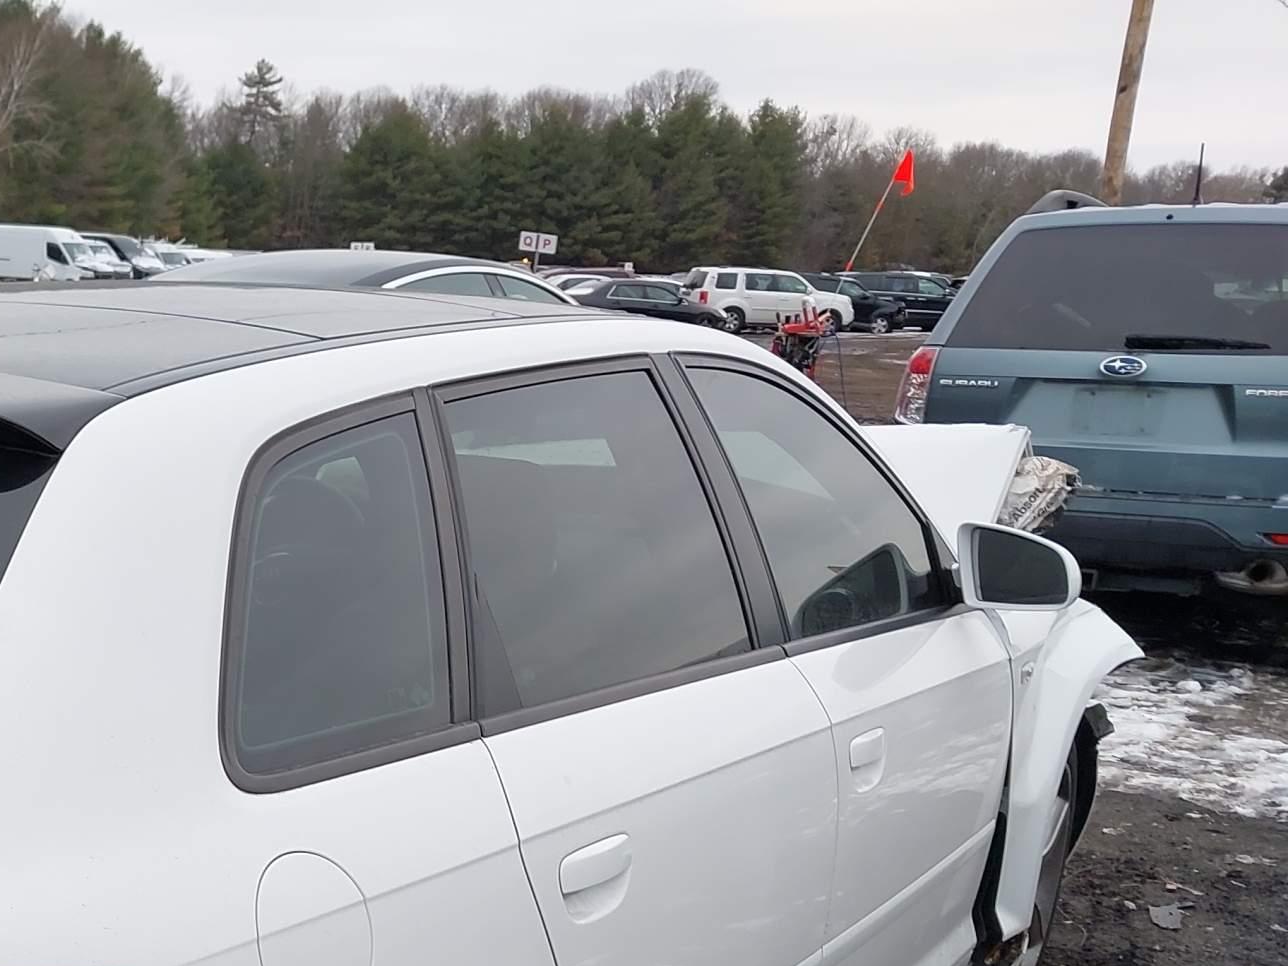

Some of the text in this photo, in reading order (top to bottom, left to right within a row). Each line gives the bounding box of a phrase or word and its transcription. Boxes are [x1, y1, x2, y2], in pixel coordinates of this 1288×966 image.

[522, 235, 533, 247] Q
[542, 238, 552, 249] P
[939, 377, 999, 388] SUBARU
